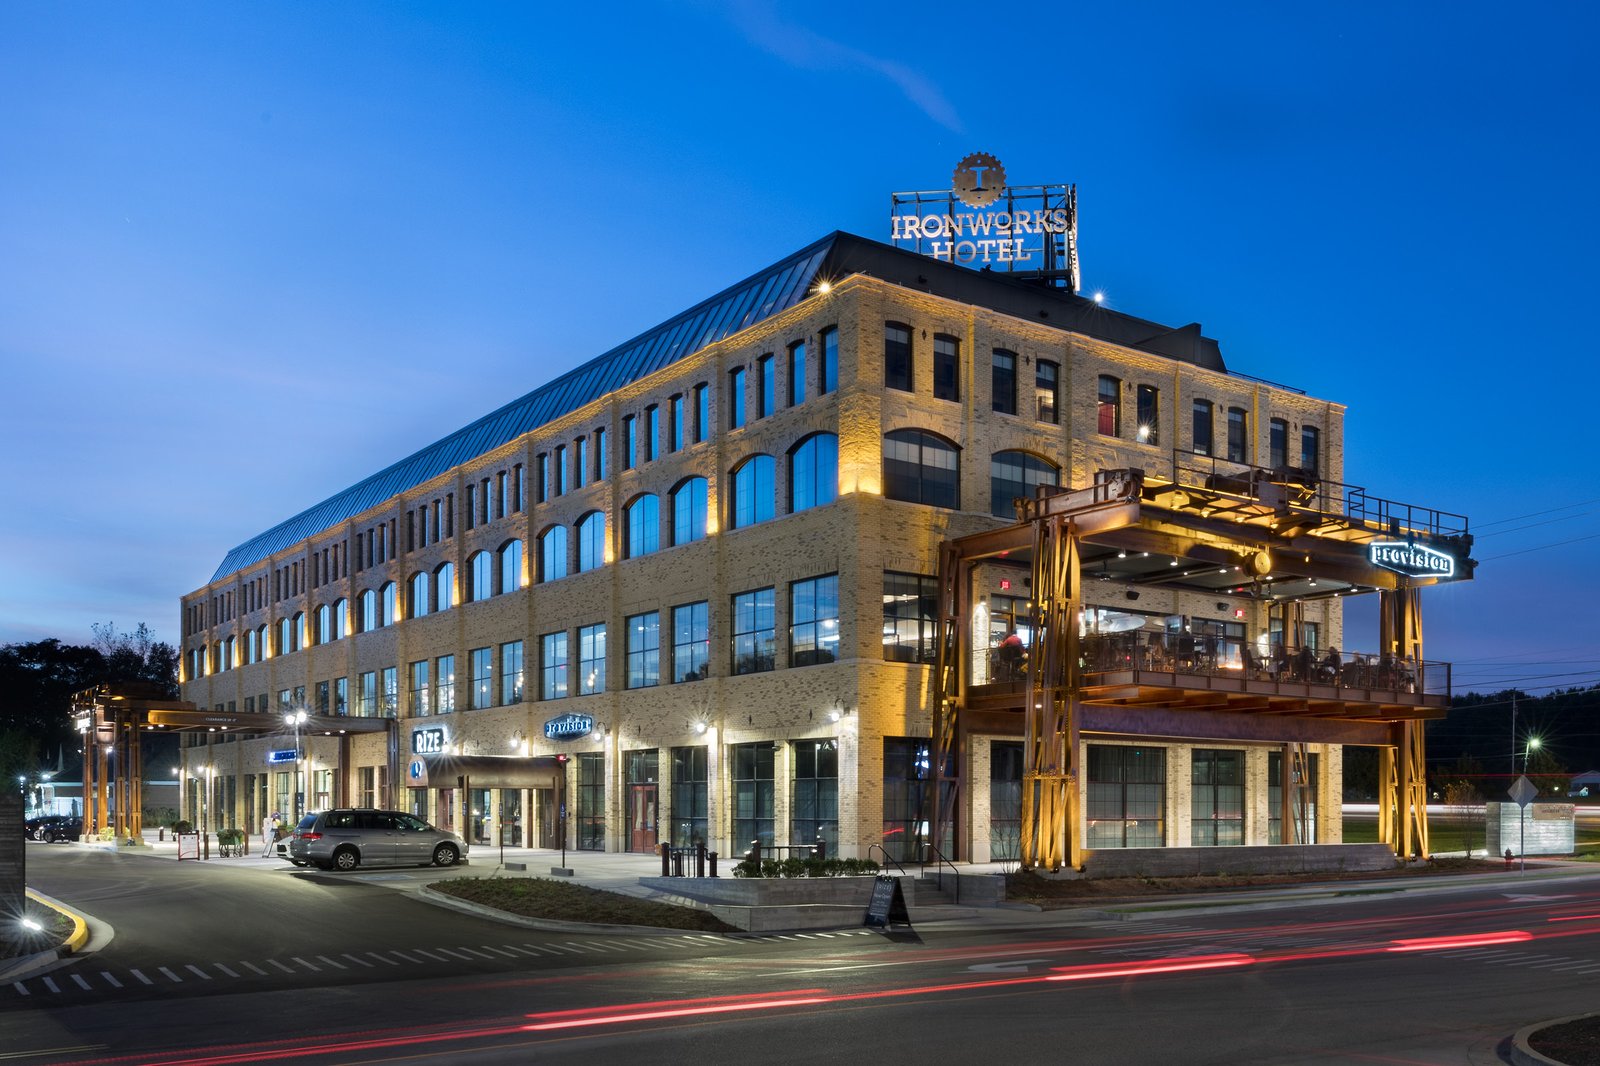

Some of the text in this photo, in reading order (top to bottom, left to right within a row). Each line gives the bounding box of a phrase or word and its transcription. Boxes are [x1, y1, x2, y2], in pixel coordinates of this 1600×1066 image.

[891, 209, 1068, 239] IRONWORKS
[931, 238, 1031, 263] HOTEL
[1371, 545, 1449, 571] provision
